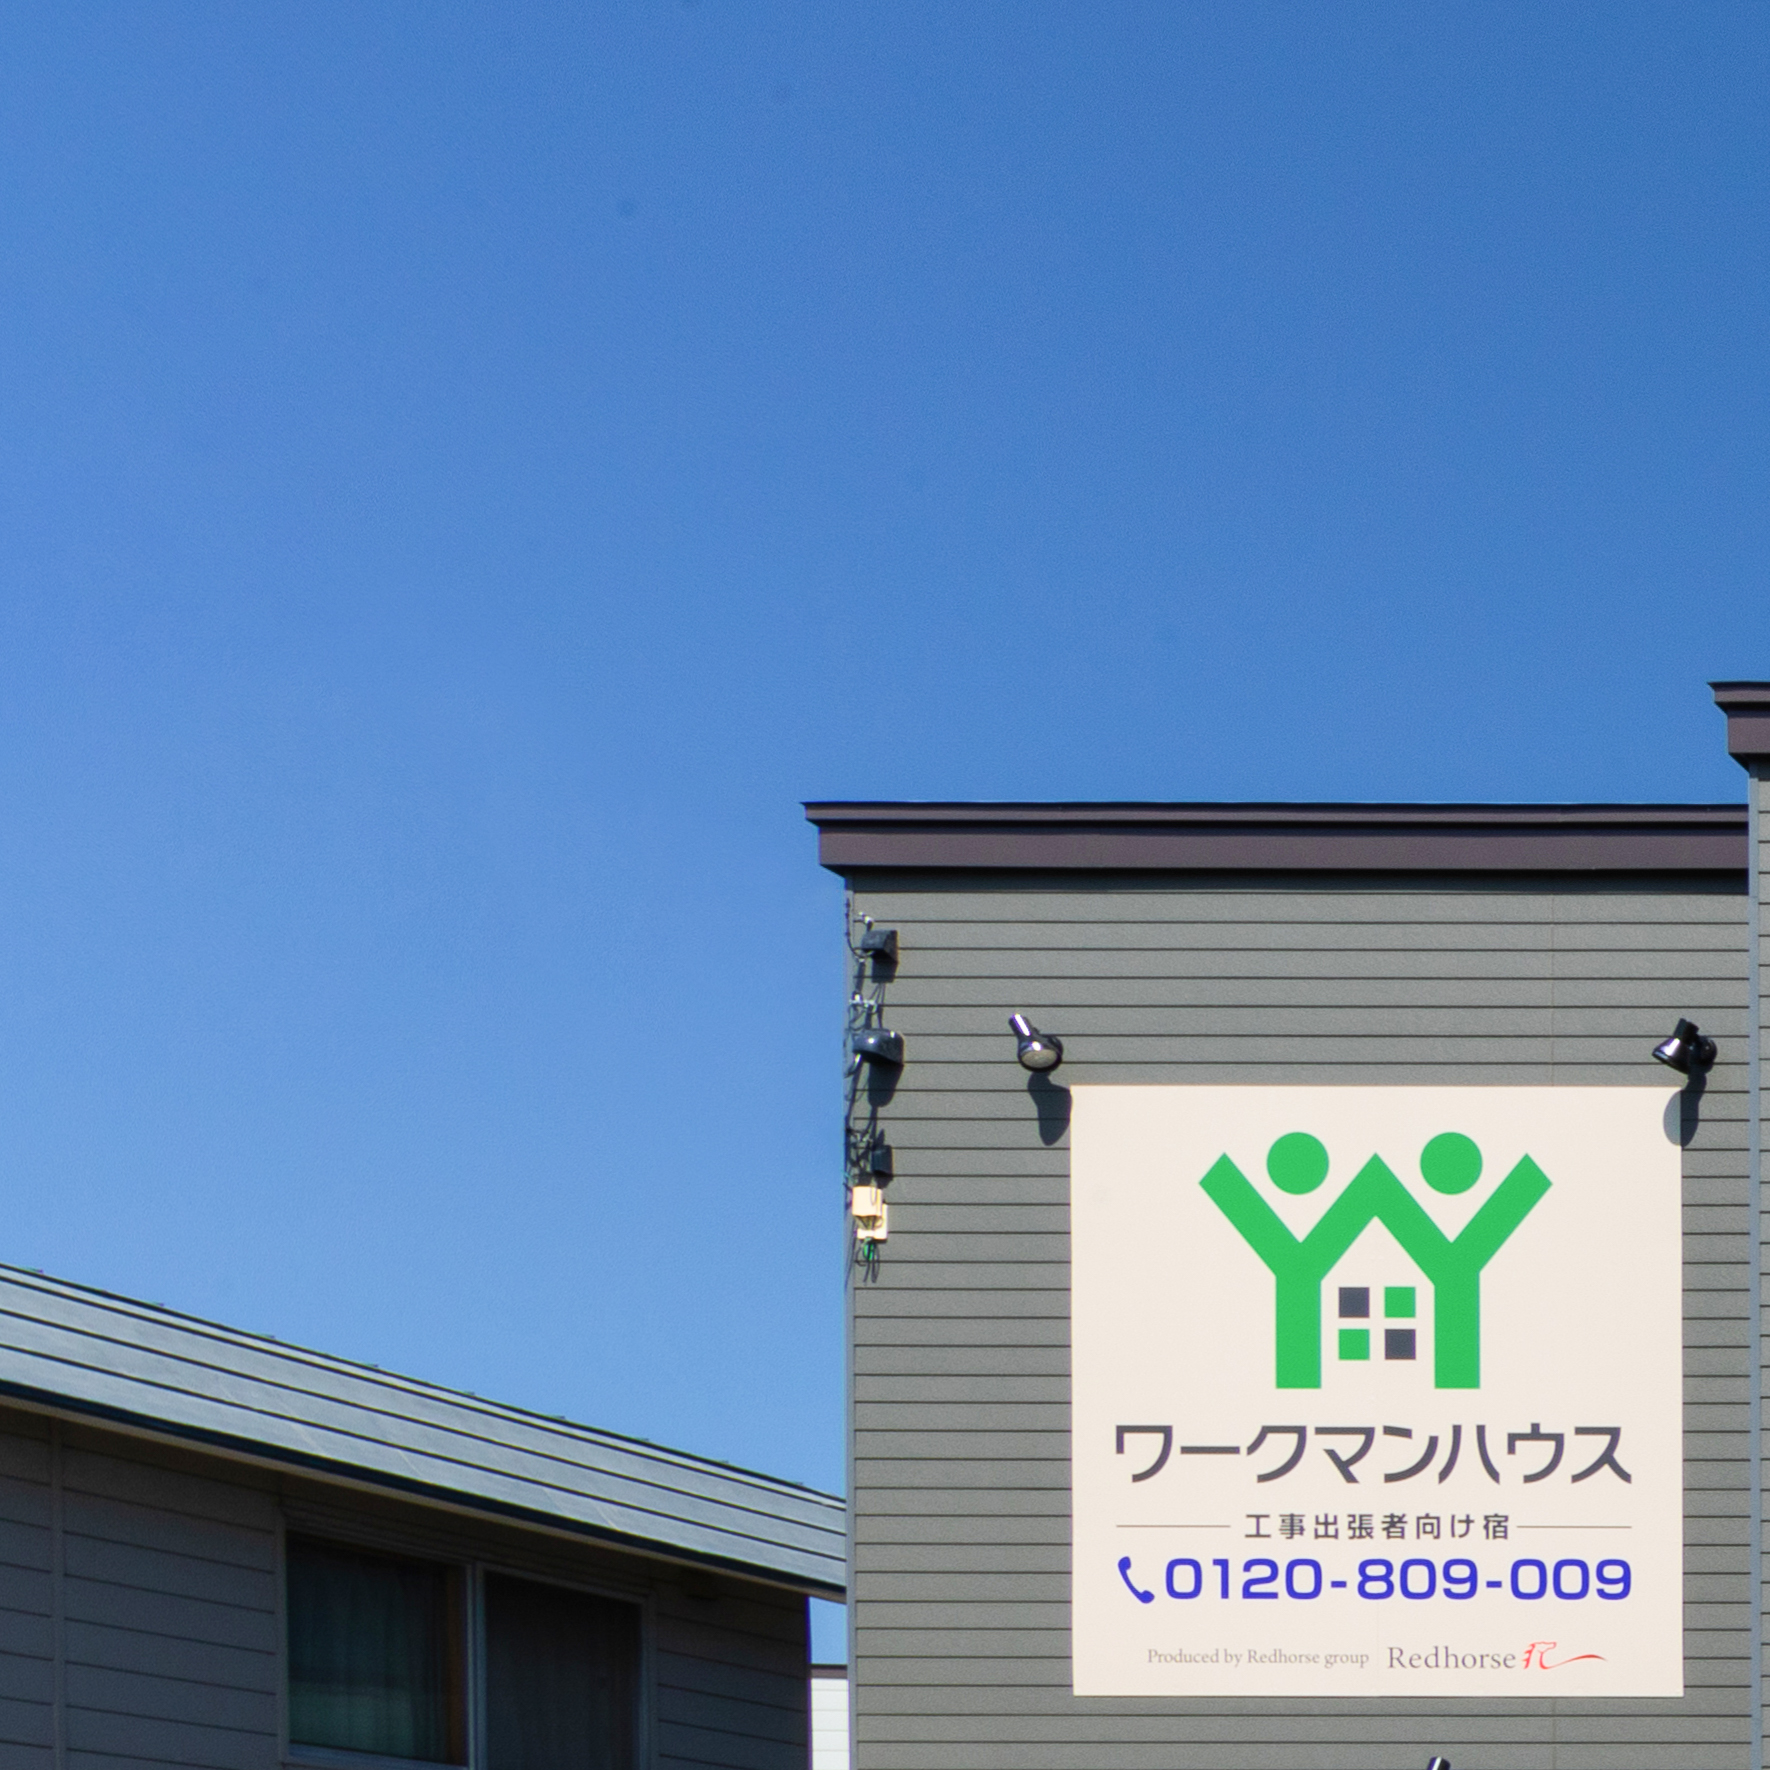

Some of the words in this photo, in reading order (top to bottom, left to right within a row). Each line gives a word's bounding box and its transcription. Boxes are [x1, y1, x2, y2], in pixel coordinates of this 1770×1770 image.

[1115, 1422, 1632, 1485] ワークマンハウス
[1244, 1512, 1509, 1540] 工事出張者向け宿
[1165, 1557, 1632, 1601] 0120-809-009
[1147, 1648, 1219, 1665] Produced
[1223, 1648, 1242, 1669] by
[1246, 1648, 1321, 1665] Redhorse
[1323, 1652, 1371, 1669] group
[1387, 1645, 1517, 1670] Redhorse
